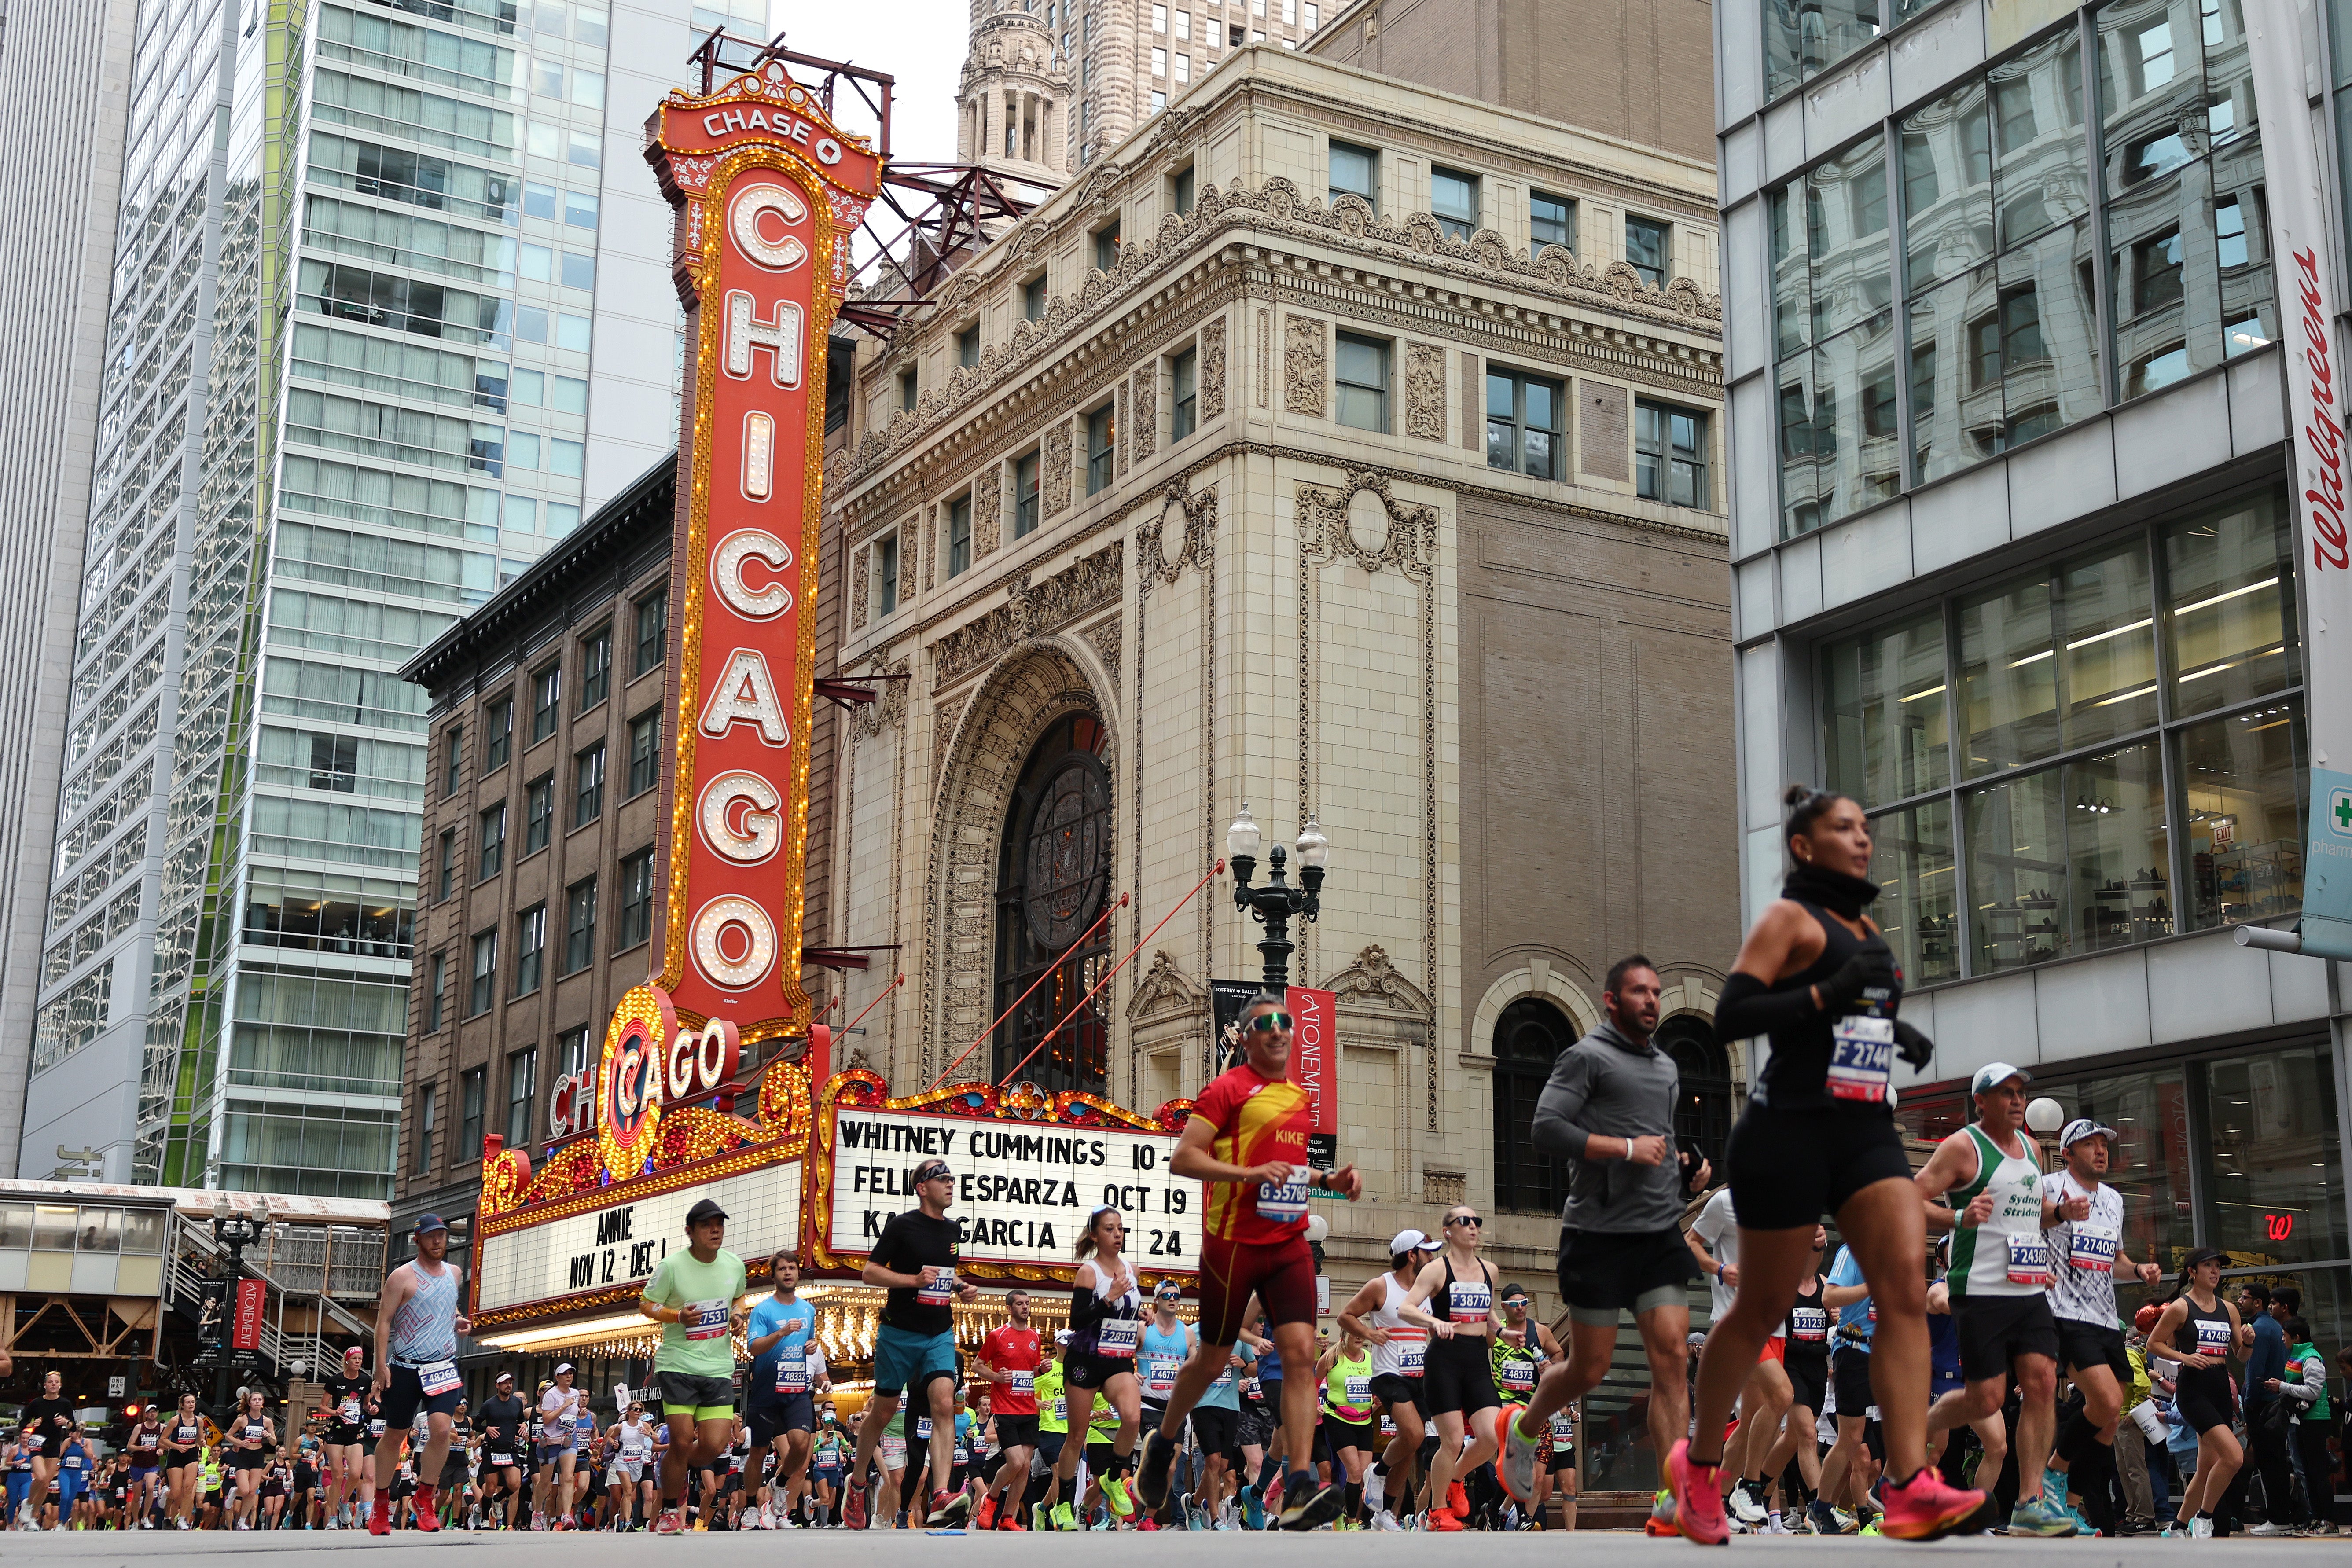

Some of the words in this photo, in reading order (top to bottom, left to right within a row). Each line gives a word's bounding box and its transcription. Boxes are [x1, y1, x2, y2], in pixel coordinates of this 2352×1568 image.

[704, 108, 813, 145] CHASE
[2293, 246, 2349, 572] Walgreens
[689, 183, 808, 992] CHICAGO
[2216, 826, 2231, 841] EXIT
[1833, 1039, 1849, 1064] F
[550, 1017, 726, 1138] CHICAGO
[839, 1120, 956, 1155] WHITNEY
[970, 1131, 1105, 1166] CUMMINGS
[1132, 1143, 1155, 1171] 10
[1275, 1129, 1305, 1146] KIKE
[961, 1174, 1079, 1208] ESPARZA
[1104, 1184, 1150, 1212] OCT
[1165, 1188, 1187, 1215] 19
[1260, 1182, 1270, 1200] G
[1308, 1187, 1333, 1197] enton
[596, 1206, 633, 1246] ANNIE
[956, 1216, 1056, 1249] GARCIA
[1150, 1229, 1182, 1257] 24
[2073, 1236, 2080, 1249] F
[2083, 1237, 2116, 1255] 27408
[569, 1252, 595, 1289] NOV
[601, 1250, 615, 1282] 12
[629, 1239, 655, 1278] DEC
[2011, 1249, 2018, 1264] F
[2020, 1249, 2047, 1265] 24383
[1451, 1294, 1458, 1306] F
[1460, 1294, 1491, 1307] 38770
[241, 1282, 257, 1347] ATONEMENT
[1794, 1318, 1800, 1327] B
[1802, 1318, 1826, 1328] 21233
[1099, 1330, 1108, 1340] F
[1108, 1331, 1136, 1343] 28313
[2198, 1330, 2204, 1340] F
[2206, 1330, 2231, 1342] 47486
[783, 1344, 803, 1353] JOÃO
[1400, 1355, 1405, 1365] F
[420, 1376, 426, 1386] F
[429, 1368, 457, 1383] 48269
[777, 1372, 783, 1381] F
[784, 1371, 805, 1381] 48332
[1502, 1369, 1507, 1377] F
[1508, 1370, 1533, 1380] 48373
[1353, 1384, 1371, 1393] 2321
[918, 1421, 922, 1429] E
